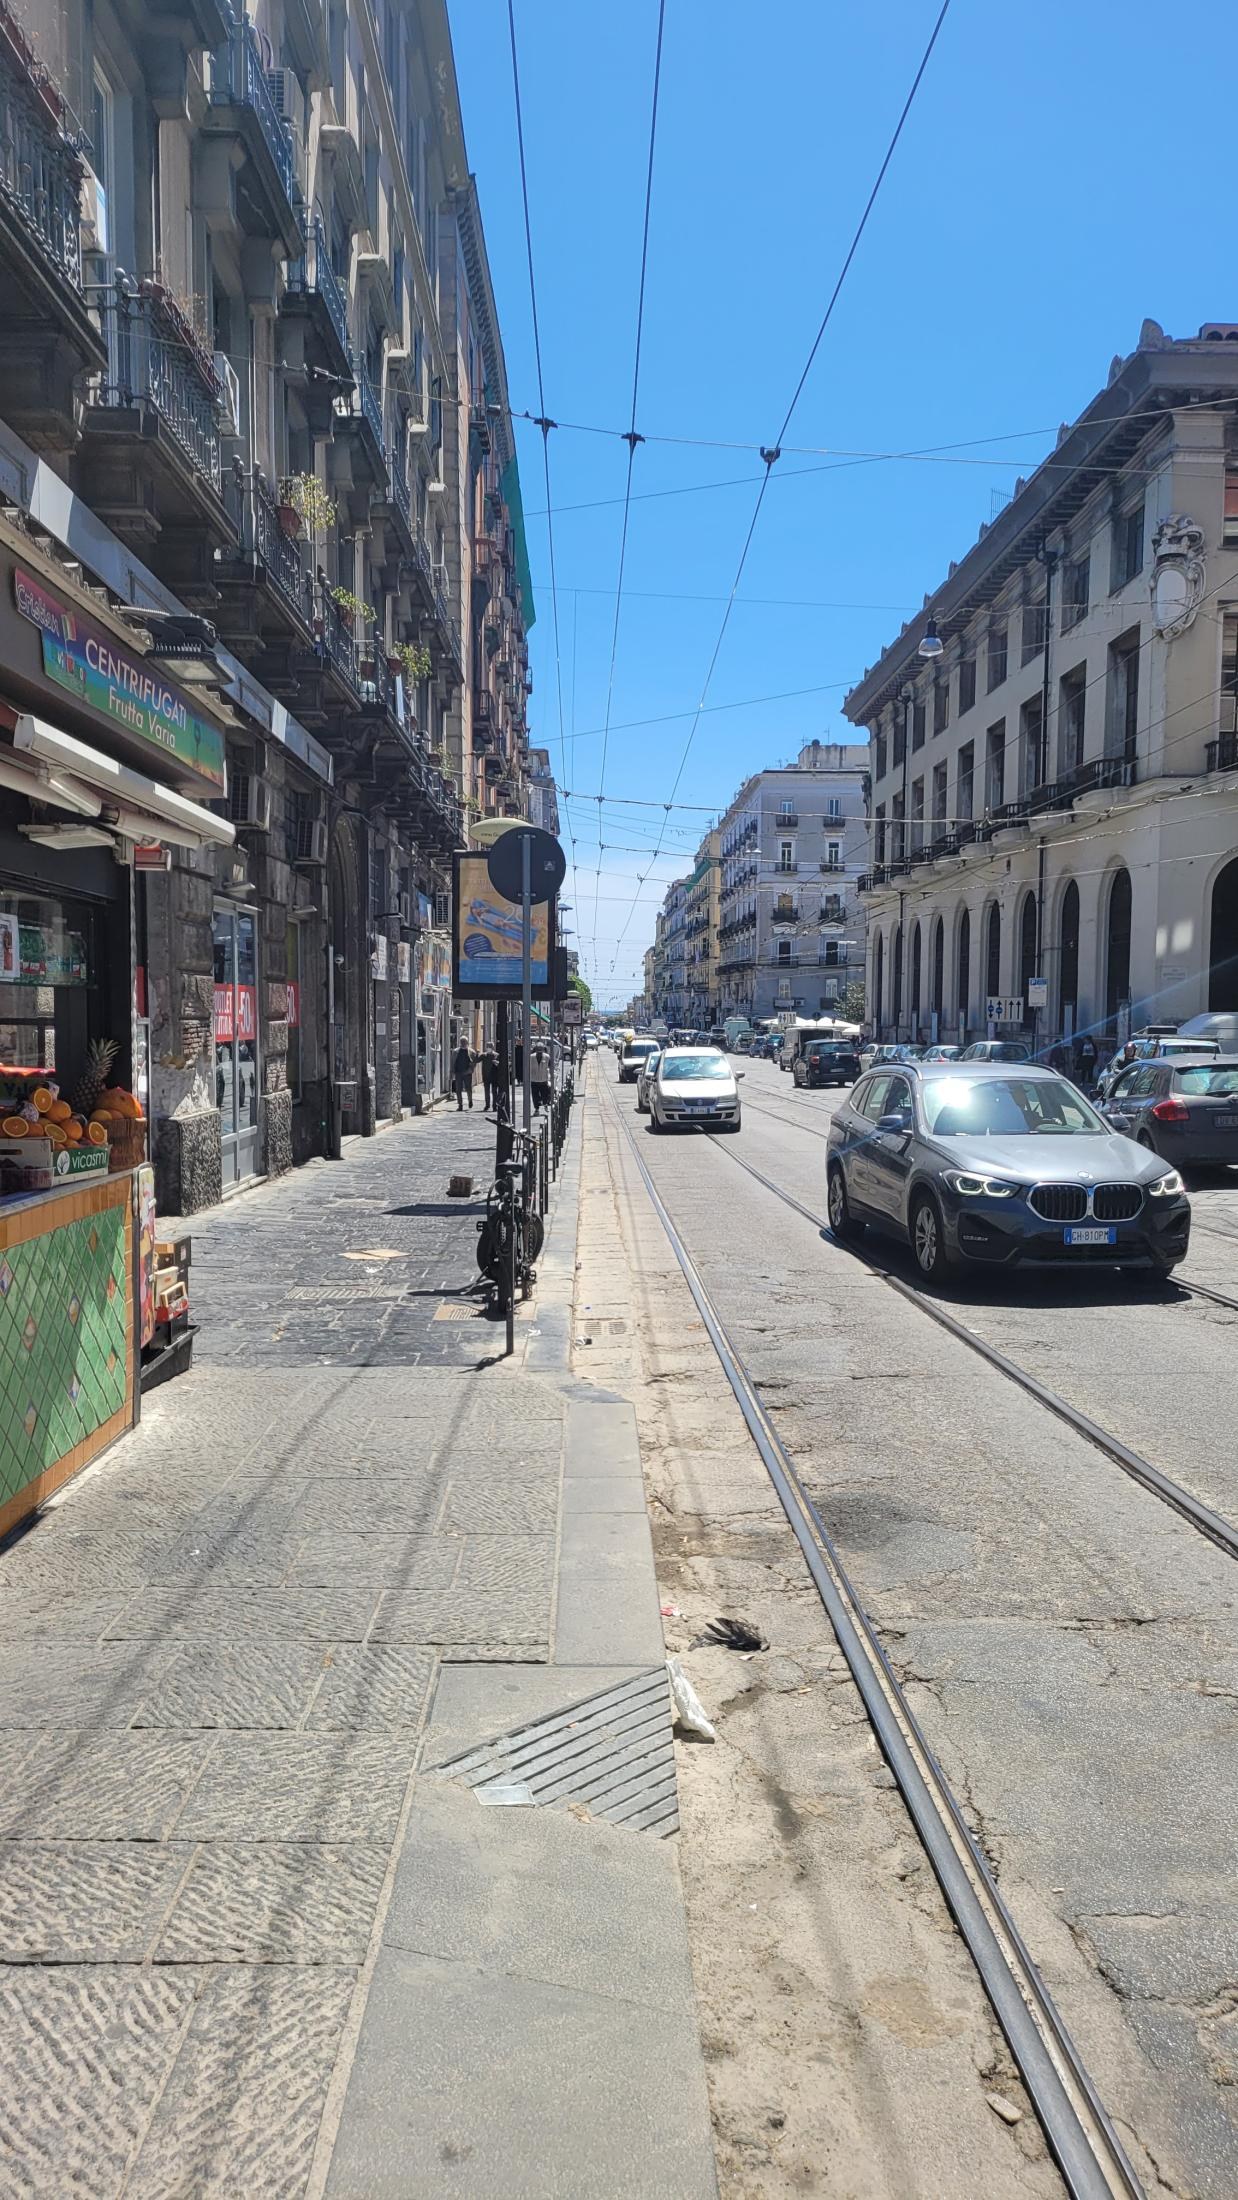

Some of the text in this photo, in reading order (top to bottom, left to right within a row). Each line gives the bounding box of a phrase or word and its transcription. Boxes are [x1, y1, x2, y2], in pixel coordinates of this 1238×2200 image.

[85, 639, 187, 731] CENTRIFUGATI
[109, 685, 176, 748] Frutta Varia
[71, 1151, 107, 1169] vicasmi
